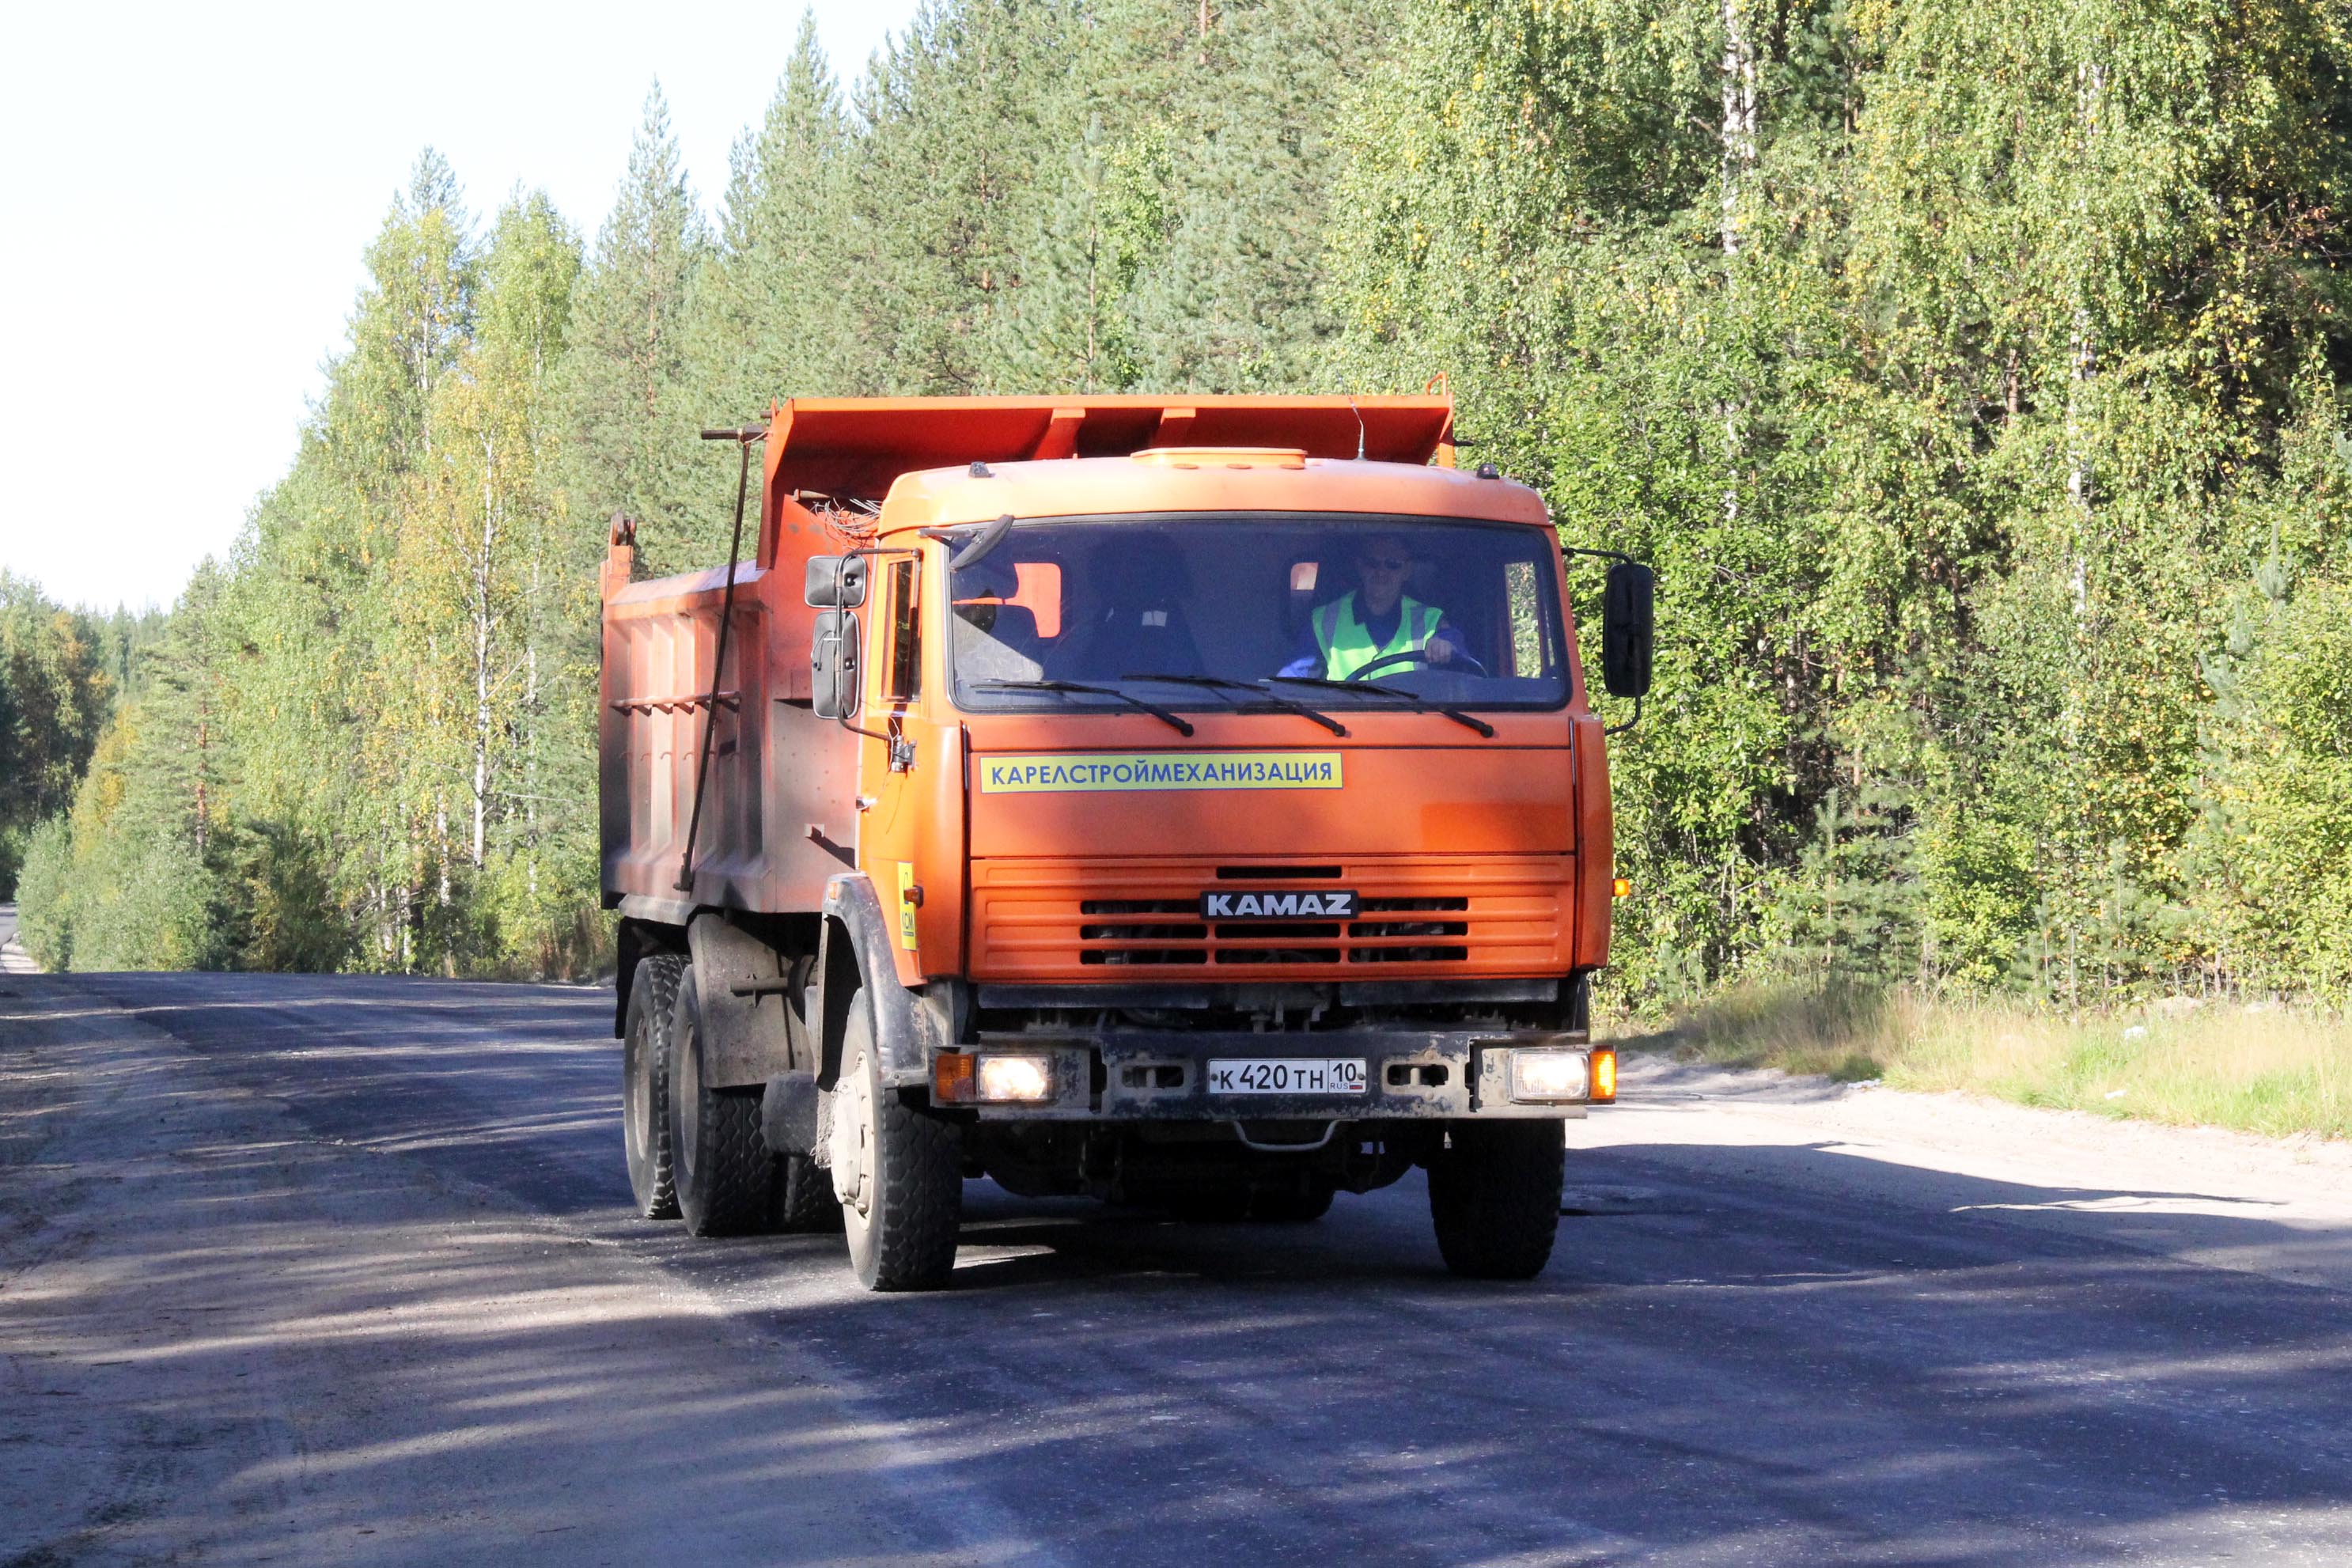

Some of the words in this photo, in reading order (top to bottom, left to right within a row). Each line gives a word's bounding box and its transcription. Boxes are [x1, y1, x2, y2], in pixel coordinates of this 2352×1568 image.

[992, 759, 1331, 785] КАРЕЛСТРОЙМЕХАНИЗАЦИЯ
[1208, 894, 1351, 916] KAMAZ
[1332, 1062, 1357, 1081] 10
